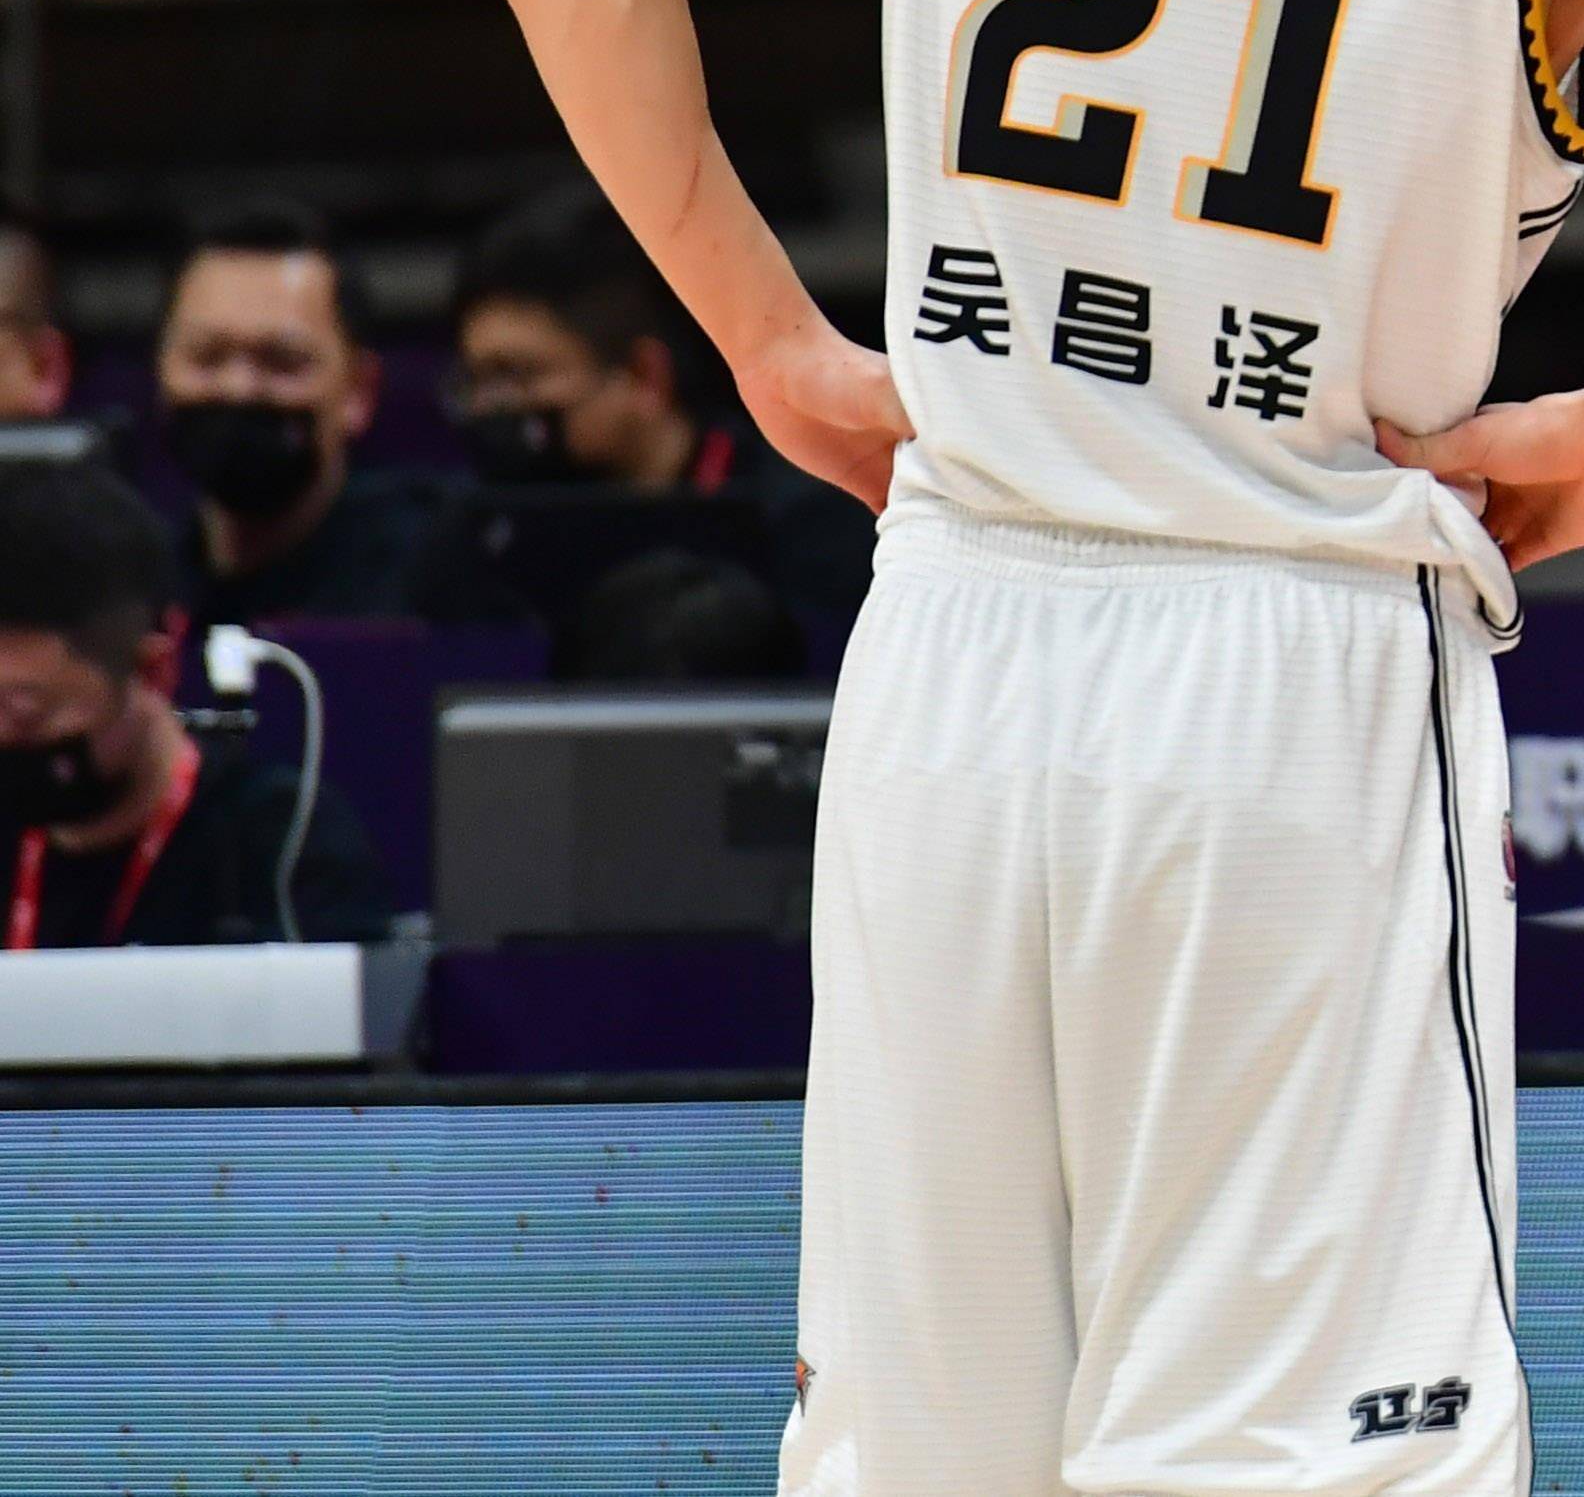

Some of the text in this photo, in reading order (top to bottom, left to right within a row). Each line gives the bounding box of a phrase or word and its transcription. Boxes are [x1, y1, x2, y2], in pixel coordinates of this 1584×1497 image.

[913, 243, 1320, 421] 吴昌泽
[1349, 1374, 1472, 1443] 辽宁
